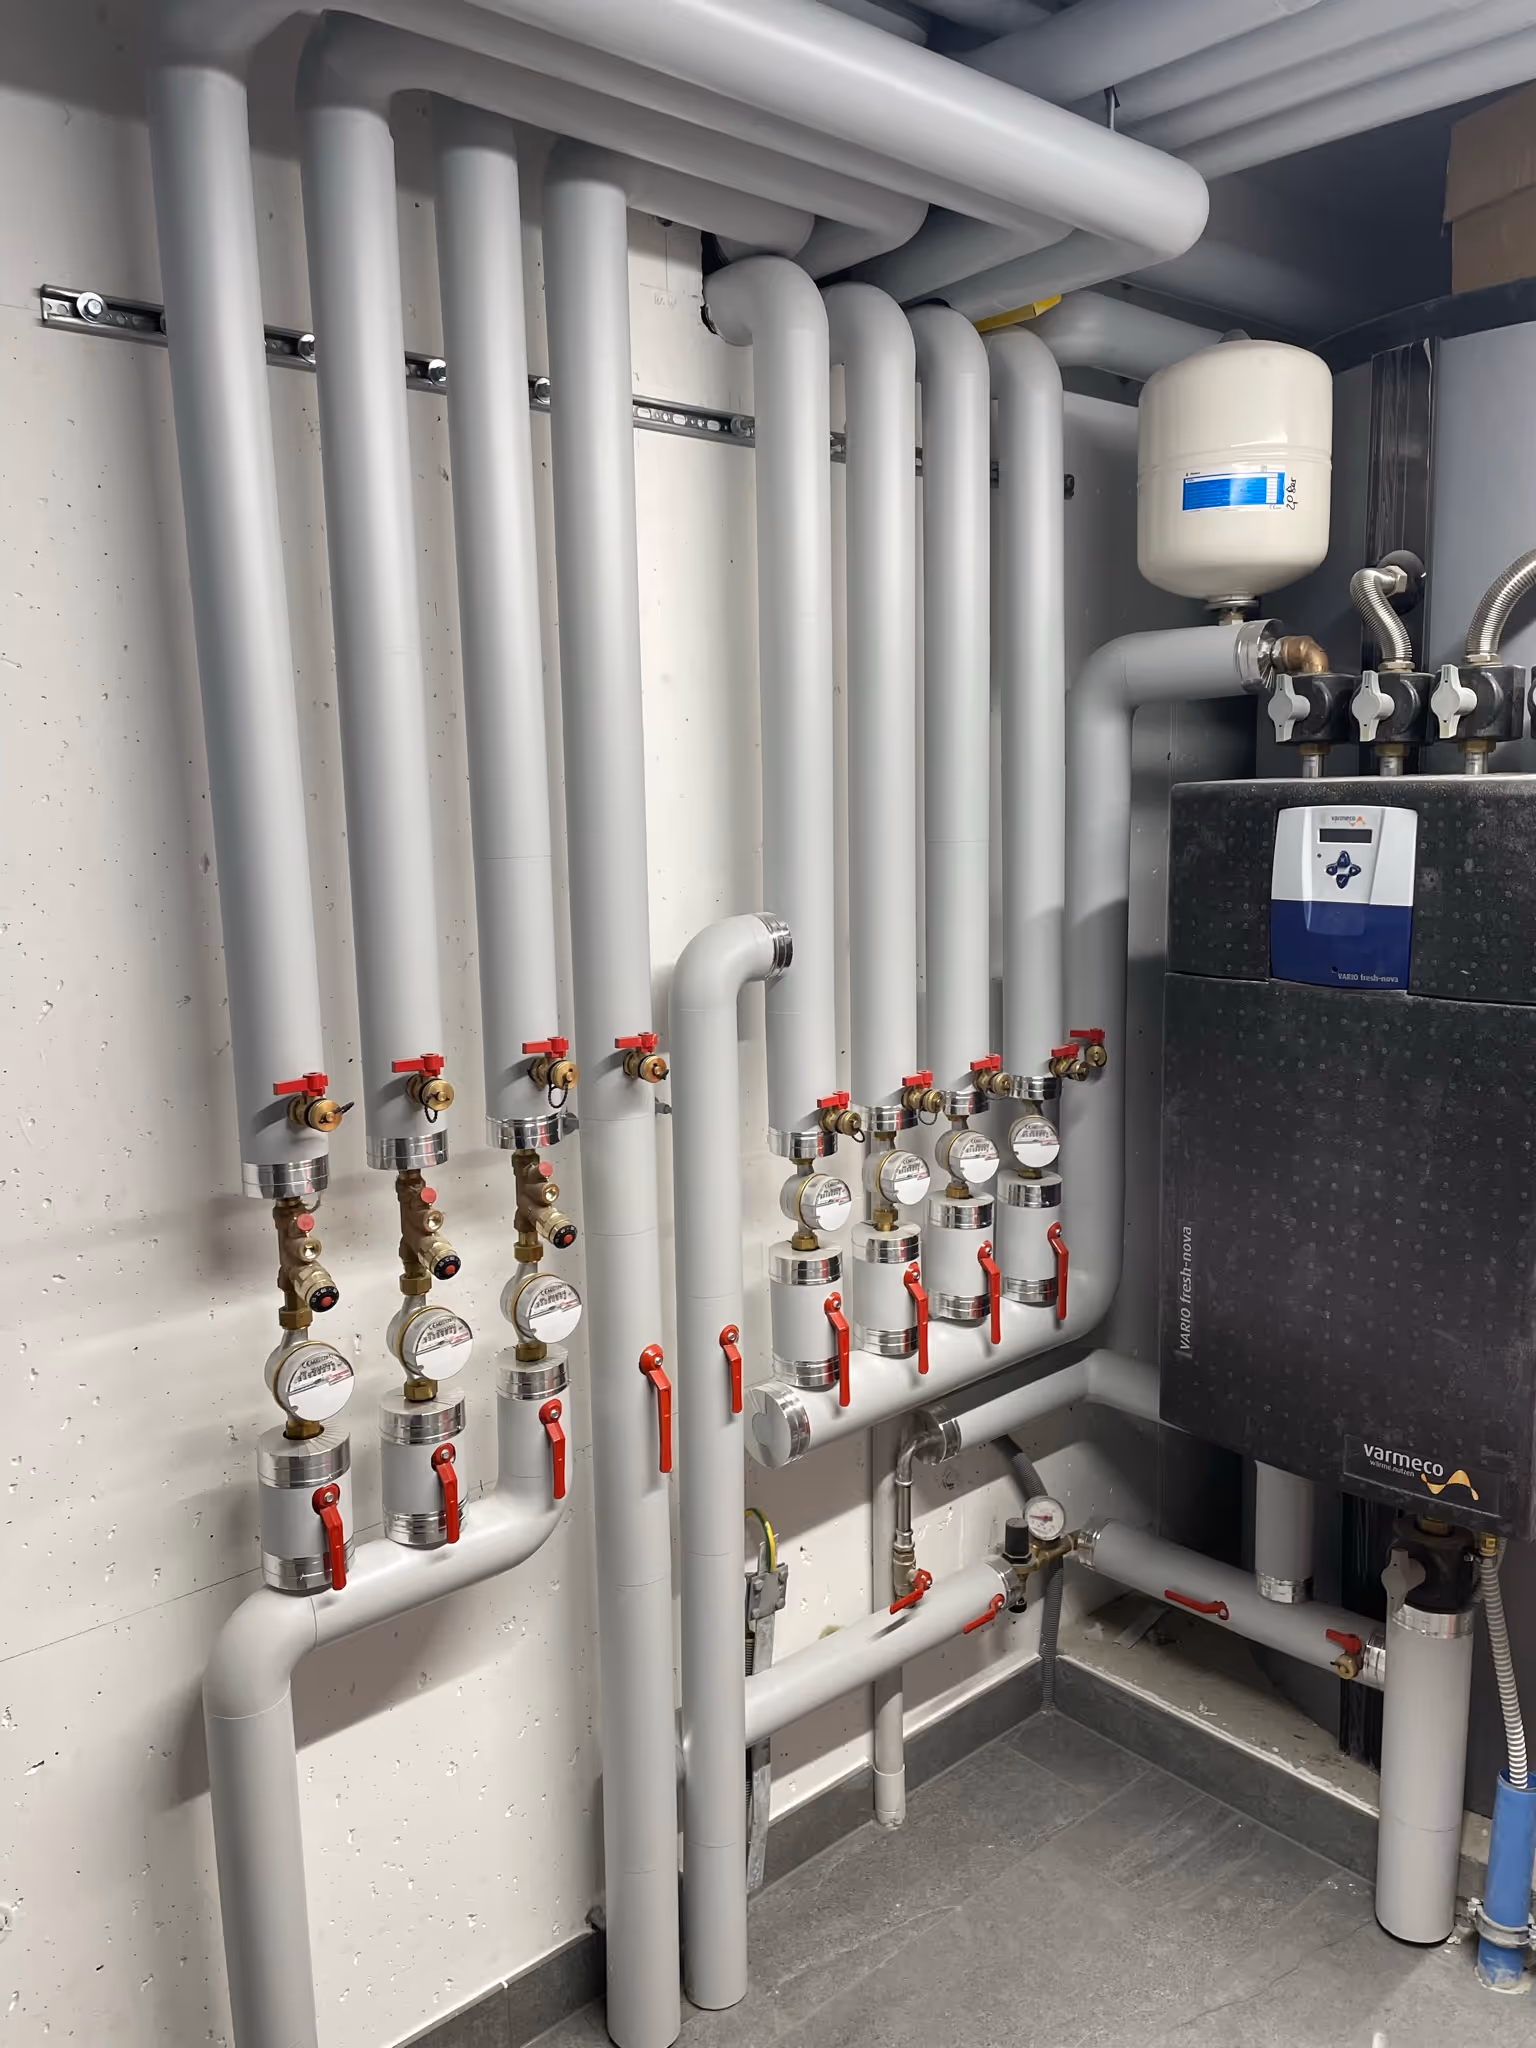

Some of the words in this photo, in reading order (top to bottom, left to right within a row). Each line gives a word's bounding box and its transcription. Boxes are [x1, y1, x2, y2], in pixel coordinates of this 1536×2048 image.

[1338, 973, 1359, 981] VARIO
[1360, 974, 1399, 983] fresh-nova
[1180, 1226, 1192, 1304] fresh-nova
[1180, 1307, 1191, 1349] VARIO
[1363, 1443, 1444, 1477] varmeco
